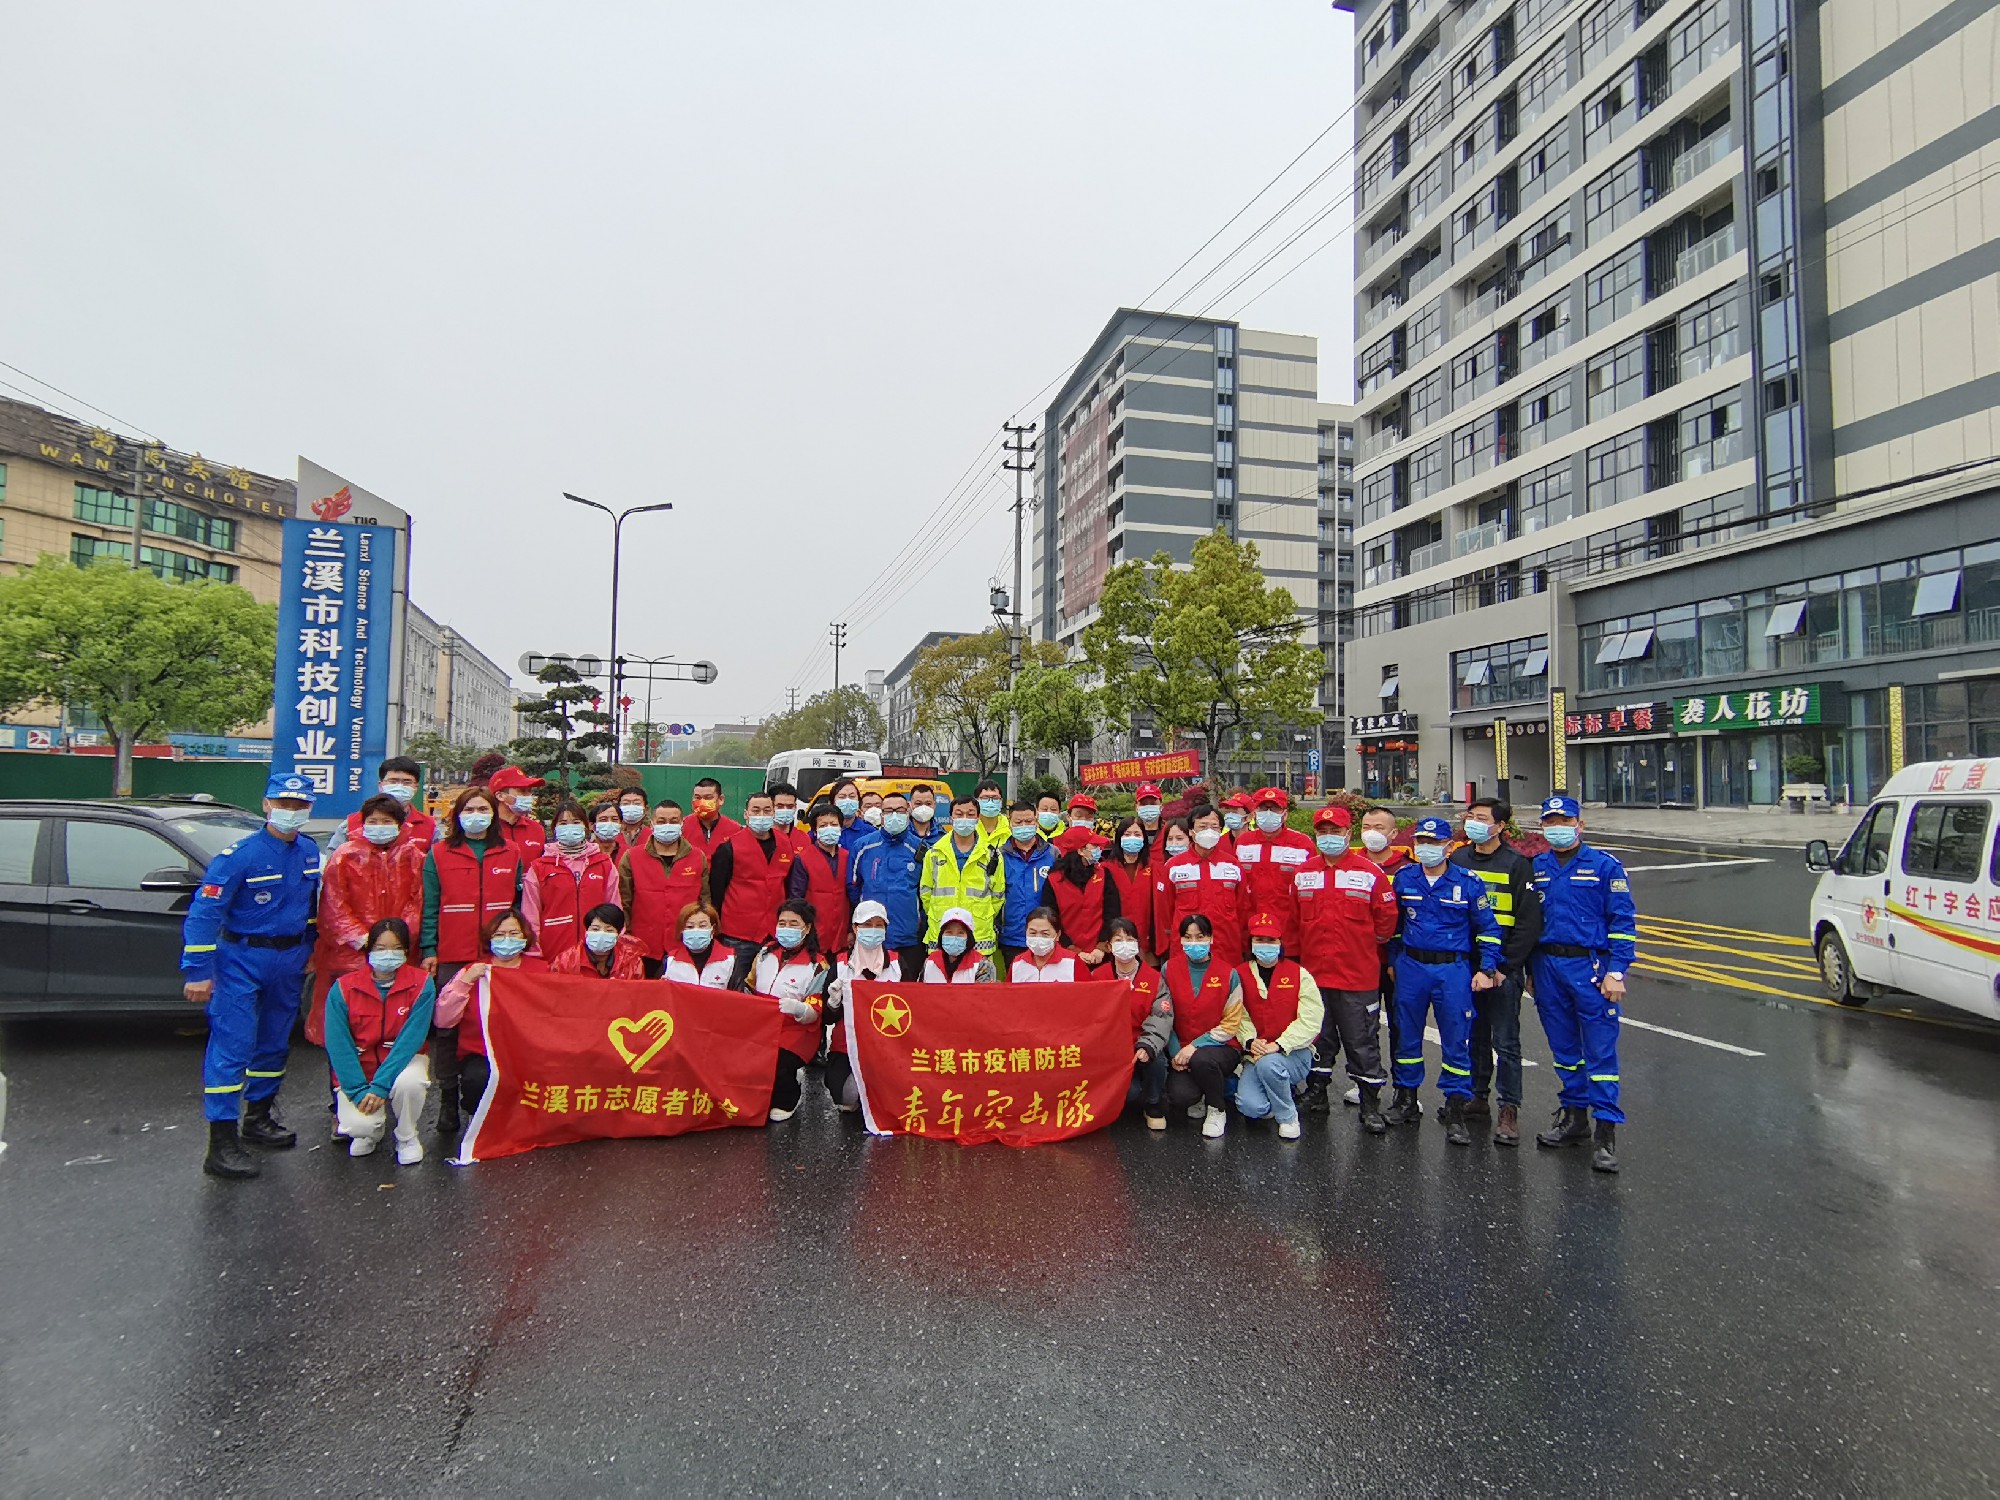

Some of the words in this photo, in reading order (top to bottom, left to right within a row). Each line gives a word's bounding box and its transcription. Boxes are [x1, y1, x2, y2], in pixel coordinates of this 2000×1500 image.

[360, 532, 373, 562] Lanxi
[357, 569, 371, 611] Science
[356, 617, 369, 639] And
[293, 527, 346, 795] 兰溪市科技创业园
[350, 647, 367, 709] Technology
[1680, 687, 1809, 725] 袭人花坊
[350, 716, 364, 760] Venture
[348, 767, 363, 792] Park
[1929, 762, 1987, 792] 应急
[910, 1044, 1082, 1075] 兰溪市疫情防控
